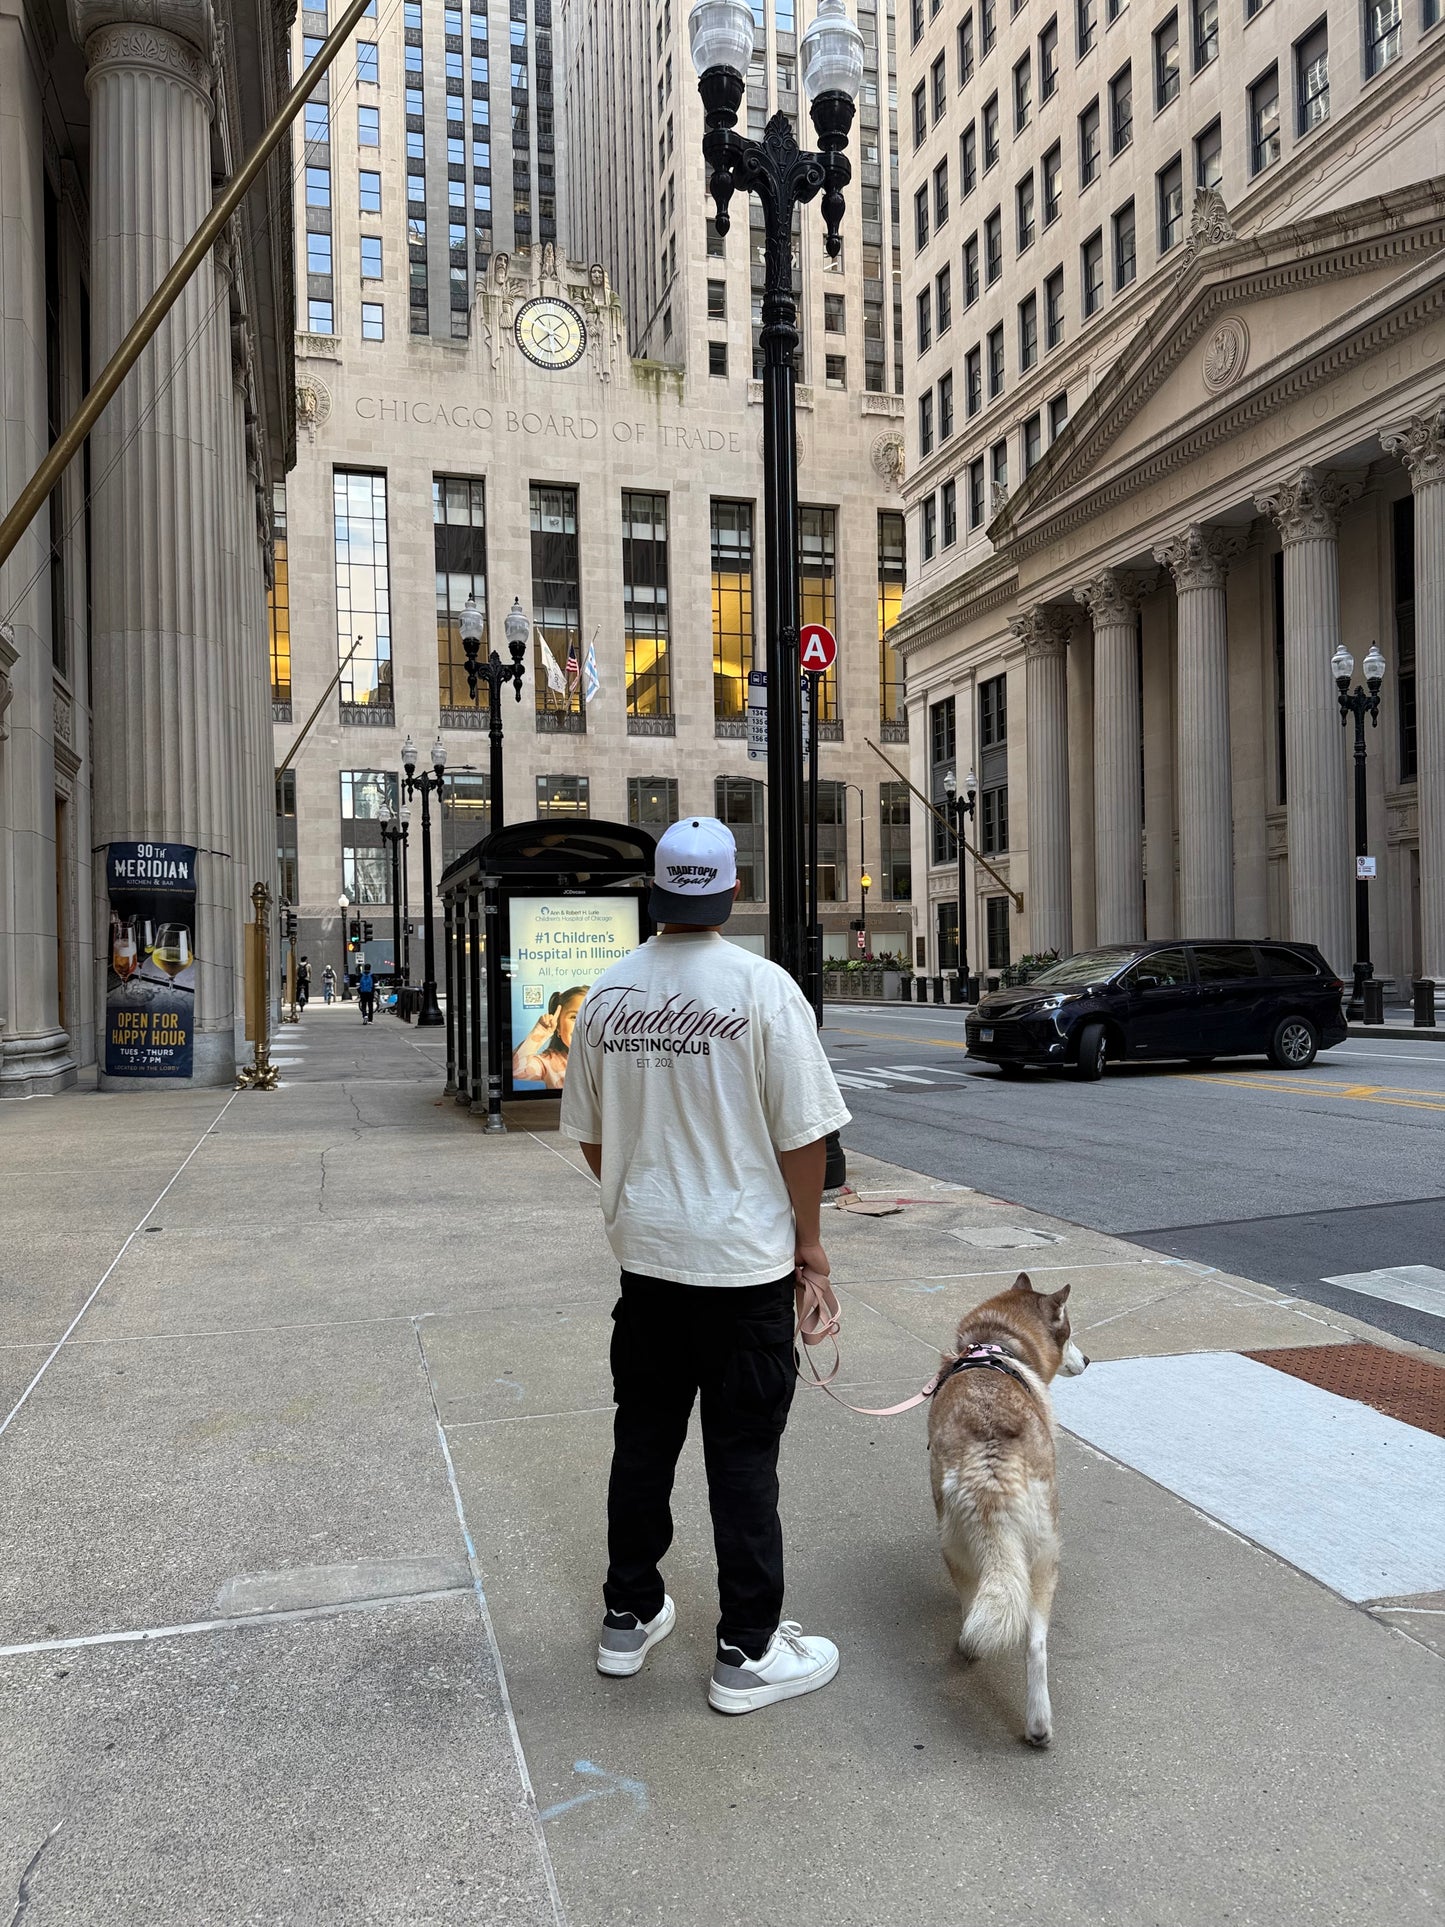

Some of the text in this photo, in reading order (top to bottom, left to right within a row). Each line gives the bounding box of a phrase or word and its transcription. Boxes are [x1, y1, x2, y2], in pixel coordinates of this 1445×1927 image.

[355, 397, 741, 453] CHICAGO BOARD OF TRADE
[1049, 514, 1118, 569] FEDERAL
[1132, 463, 1217, 520] RESERVE
[1236, 414, 1297, 462] BANK
[1313, 386, 1346, 419] OF
[803, 634, 827, 663] A
[115, 860, 188, 879] MERIDIAN
[666, 865, 718, 878] TRADETOPIA
[668, 873, 716, 889] Legacy
[535, 931, 615, 944] #1 Children's
[518, 947, 572, 962] Hospital
[576, 947, 588, 959] in
[538, 967, 554, 977] All,
[555, 966, 569, 976] for
[571, 967, 592, 978] your
[118, 1012, 178, 1029] OPEN FOR
[584, 983, 750, 1057] Tradetopia
[112, 1029, 186, 1046] HAPPY HOUR
[120, 1048, 138, 1056] TUES
